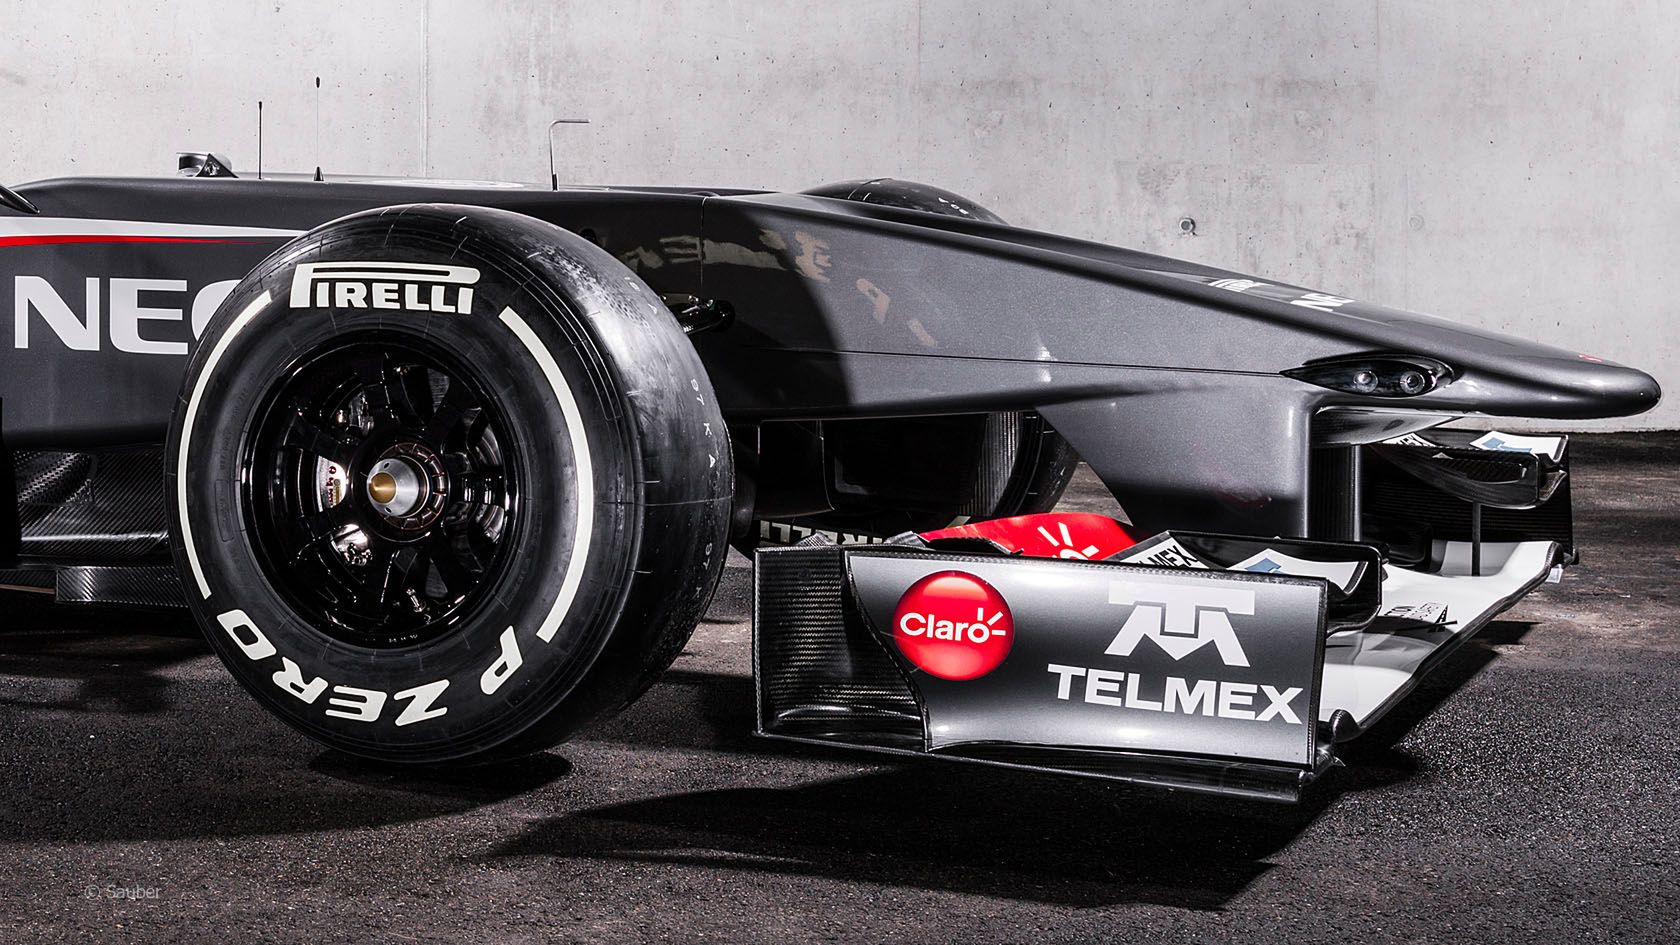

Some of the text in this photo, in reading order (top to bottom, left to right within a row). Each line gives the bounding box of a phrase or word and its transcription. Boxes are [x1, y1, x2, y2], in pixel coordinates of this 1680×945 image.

[290, 262, 480, 314] PIRELLI
[900, 611, 992, 644] Claro
[217, 609, 450, 727] ZERO
[1047, 664, 1304, 724] TELMEX
